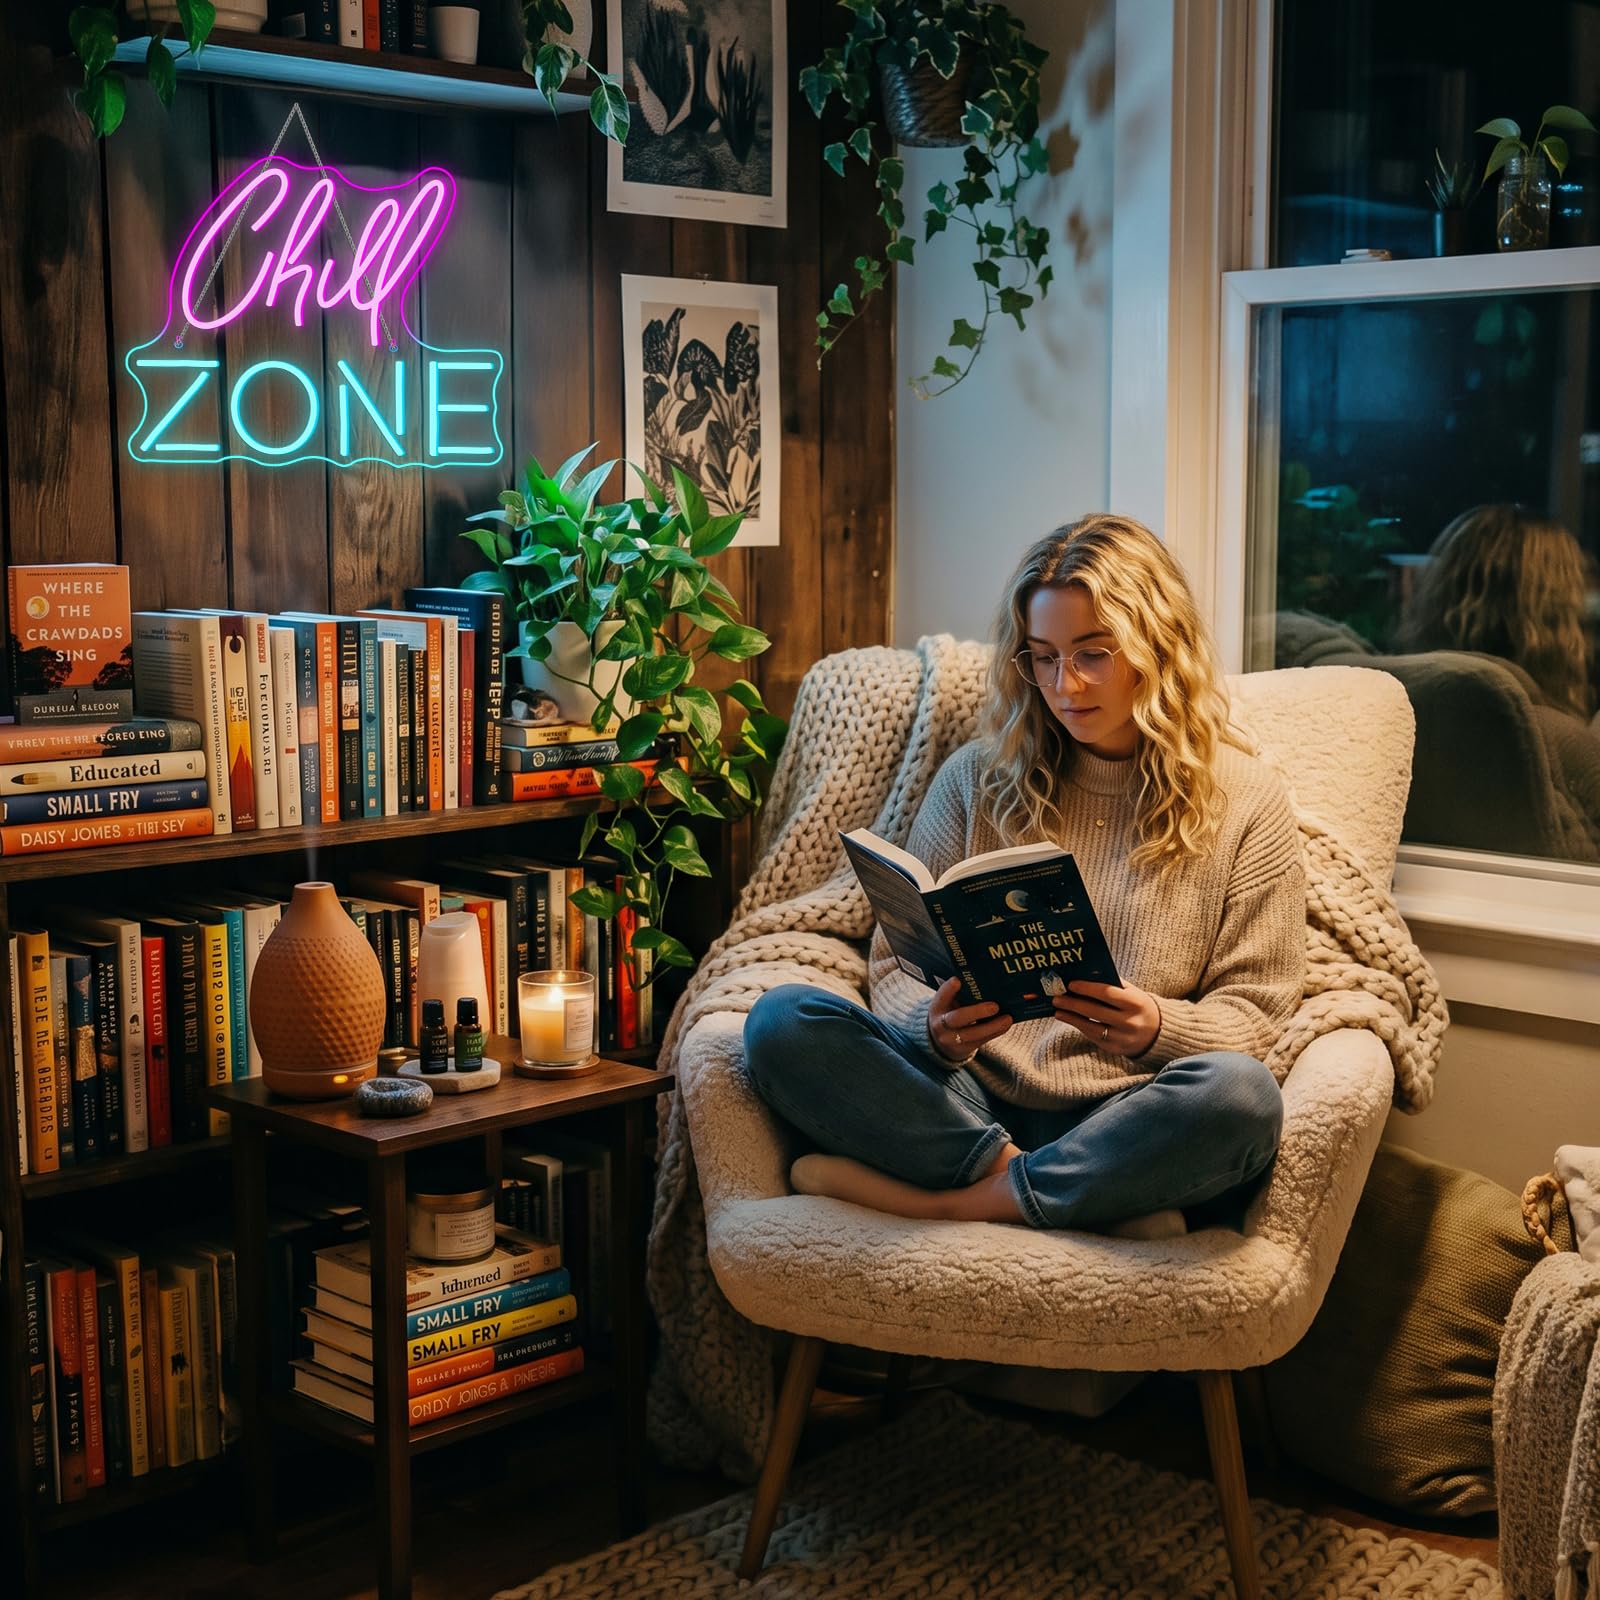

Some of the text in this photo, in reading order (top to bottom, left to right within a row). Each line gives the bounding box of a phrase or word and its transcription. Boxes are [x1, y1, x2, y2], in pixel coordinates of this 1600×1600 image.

[181, 168, 445, 347] Chill
[136, 359, 494, 457] ZONE
[43, 582, 104, 595] WHERE
[57, 604, 91, 617] THE
[26, 626, 123, 641] CRAWDADS
[55, 648, 97, 663] SING
[70, 759, 161, 783] Educated
[47, 794, 103, 817] SMALL
[109, 790, 140, 811] FRY
[21, 829, 66, 848] DAISY
[1019, 921, 1046, 935] THE
[988, 928, 1085, 960] MIDNIGHT
[1003, 947, 1084, 974] LIBRARY
[416, 1295, 503, 1333] SMALL FRY
[412, 1333, 467, 1362] SMALL
[472, 1322, 502, 1345] FRY
